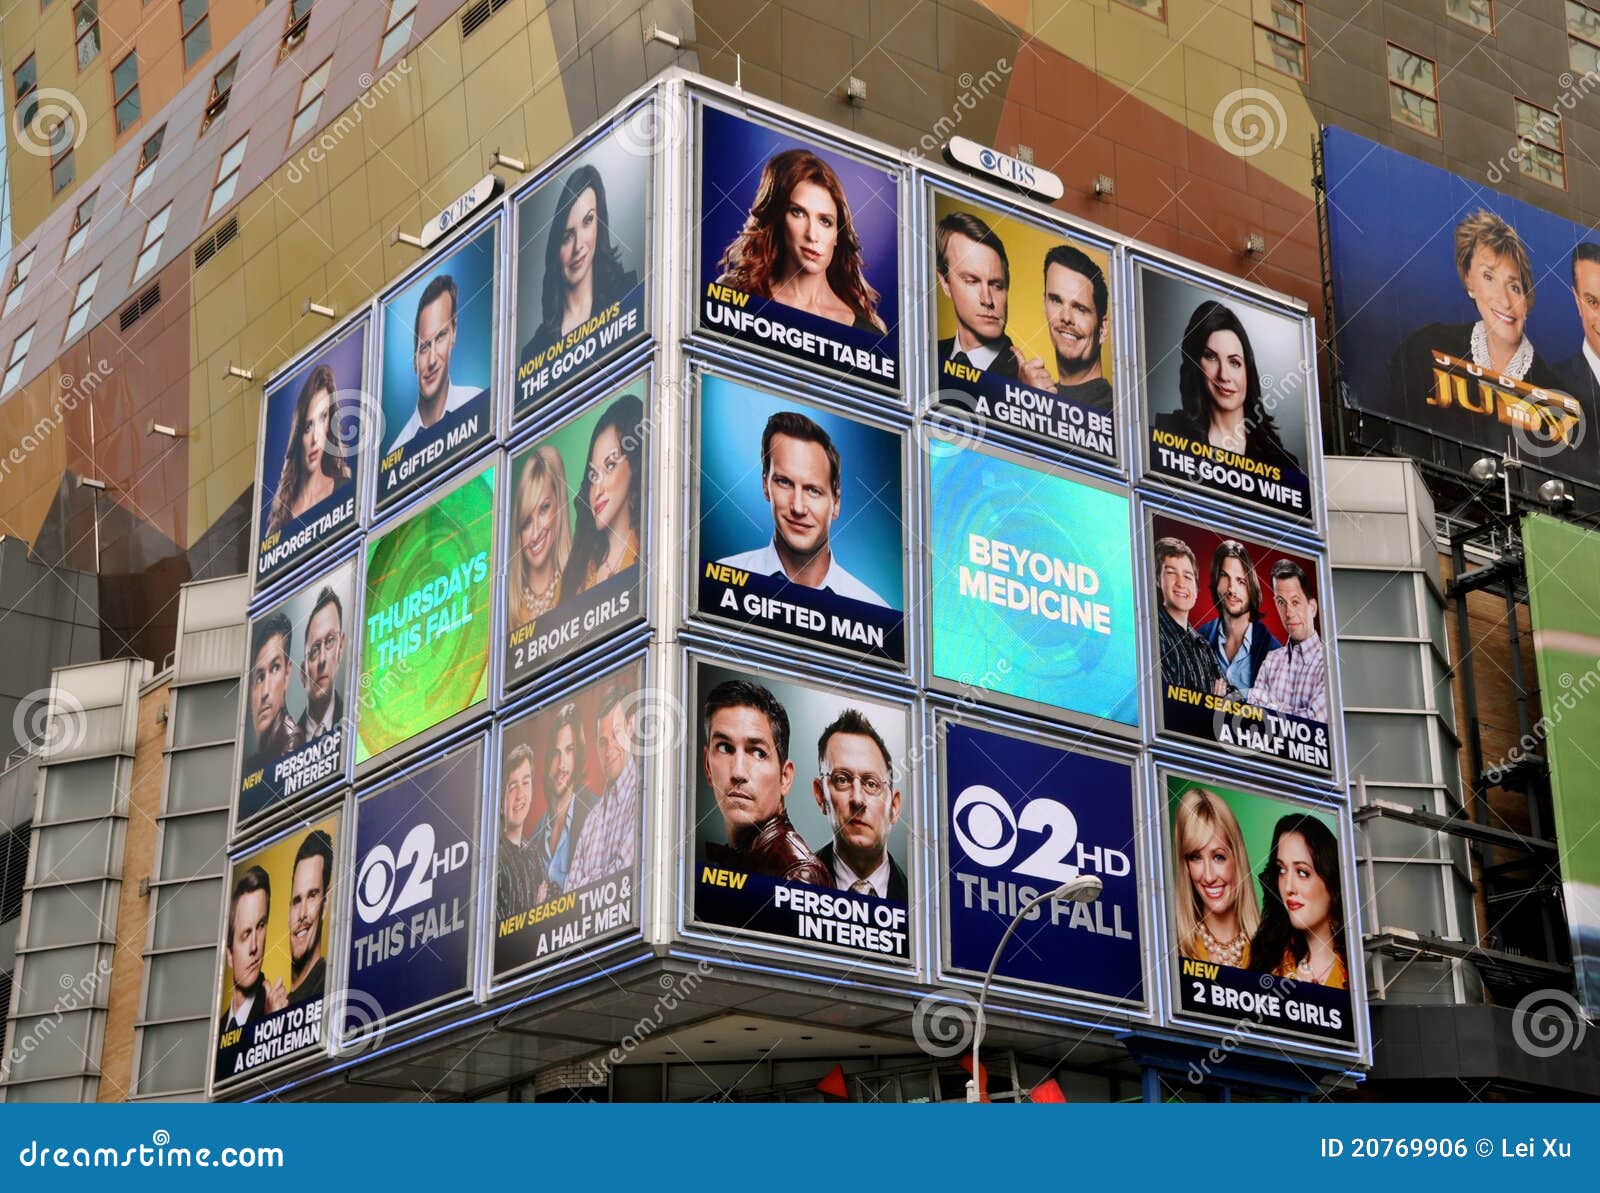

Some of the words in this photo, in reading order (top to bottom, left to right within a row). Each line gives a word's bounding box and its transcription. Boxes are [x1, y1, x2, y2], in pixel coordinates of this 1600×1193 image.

[997, 154, 1036, 187] CBS
[707, 283, 750, 308] NEW
[518, 351, 545, 381] NOW
[547, 340, 564, 361] ON
[566, 301, 621, 349] SUNDAYS
[522, 367, 549, 400] THE
[552, 338, 596, 379] GOOD
[599, 308, 637, 348] WIFE
[706, 301, 895, 379] UNFORGETTABLE
[944, 360, 982, 383] NEW
[1434, 354, 1579, 412] JUDGE
[975, 395, 991, 416] A
[994, 402, 1113, 456] GENTLEMAN
[1006, 384, 1053, 416] HOW
[1057, 401, 1084, 425] TO
[1088, 411, 1112, 436] BE
[381, 447, 404, 473] NEW
[387, 470, 397, 490] A
[400, 438, 445, 480] GIFTED
[447, 415, 478, 450] MAN
[1153, 429, 1188, 451] NOW
[1191, 441, 1213, 459] ON
[1216, 450, 1281, 480] SUNDAYS
[1158, 448, 1195, 475] THE
[1199, 461, 1255, 492] GOOD
[1258, 478, 1303, 509] WIFE
[259, 498, 354, 573] UNFORGETTABLE
[260, 529, 281, 554] NEW
[705, 562, 750, 587] NEW
[968, 533, 1099, 596] BEYOND
[367, 551, 488, 644] THURSDAYS
[720, 588, 738, 611] A
[743, 593, 826, 632] GIFTED
[831, 615, 884, 648] MAN
[959, 565, 1111, 635] MEDICINE
[377, 623, 422, 670] THIS
[426, 595, 473, 644] FALL
[509, 621, 536, 648] NEW
[514, 648, 524, 670] 2
[528, 616, 580, 662] BROKE
[583, 590, 630, 631] GIRLS
[1167, 684, 1202, 705] NEW
[1204, 695, 1263, 722] SEASON
[1267, 714, 1311, 743] TWO
[1314, 727, 1328, 748] &
[274, 742, 321, 783] PERSON
[323, 731, 341, 754] OF
[1219, 723, 1235, 745] A
[1237, 727, 1285, 755] HALF
[1288, 743, 1329, 768] MEN
[242, 768, 264, 792] NEW
[284, 751, 340, 796] INTEREST
[432, 841, 469, 879] HD
[701, 866, 748, 890] NEW
[1076, 841, 1131, 877] HD
[499, 911, 527, 938] NEW
[528, 892, 577, 926] SEASON
[579, 882, 617, 915] TWO
[620, 876, 631, 899] &
[535, 933, 549, 957] A
[551, 916, 592, 951] HALF
[594, 901, 631, 934] MEN
[774, 885, 869, 924] PERSON
[874, 905, 906, 930] OF
[956, 872, 1041, 921] THIS
[1051, 896, 1133, 940] FALL
[354, 921, 405, 971] THIS
[410, 897, 465, 949] FALL
[798, 914, 907, 955] INTEREST
[1183, 959, 1220, 981] NEW
[254, 1014, 286, 1045] HOW
[286, 1007, 304, 1031] TO
[305, 999, 323, 1024] BE
[1192, 981, 1206, 1004] 2
[1210, 985, 1281, 1018] BROKE
[1285, 1000, 1343, 1030] GIRLS
[220, 1027, 243, 1049] NEW
[234, 1052, 244, 1073] A
[245, 1021, 321, 1068] GENTLEMAN
